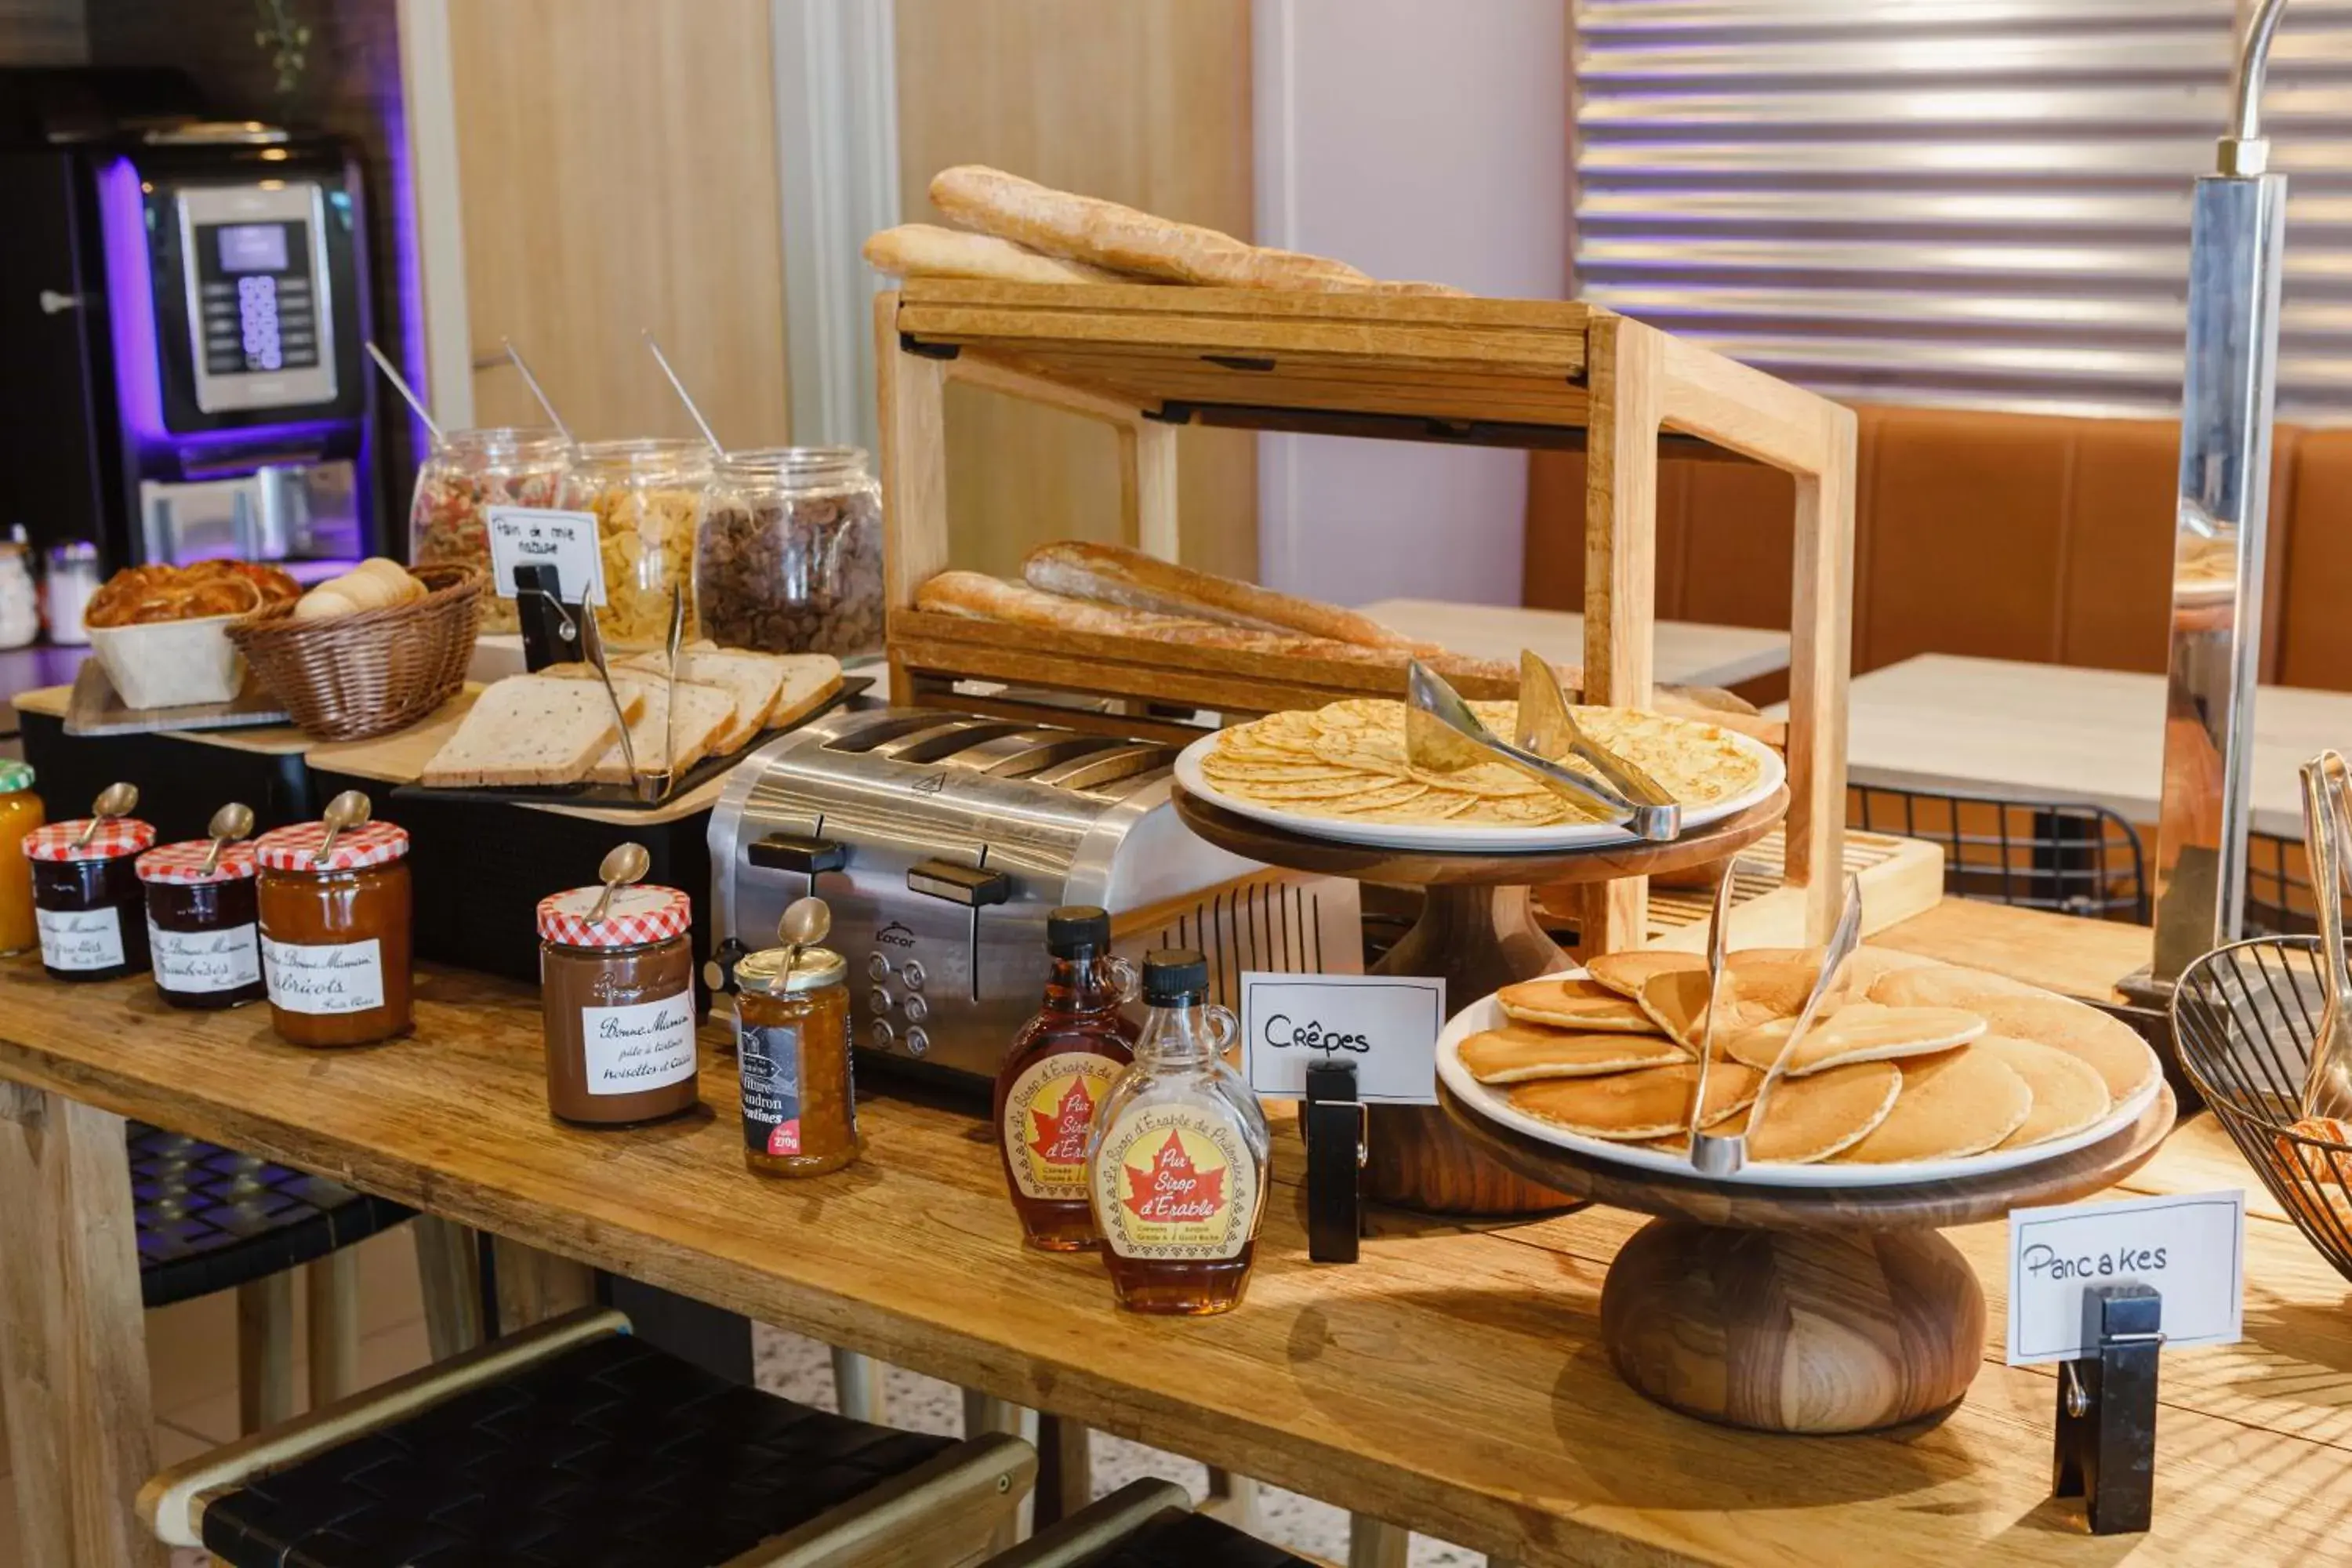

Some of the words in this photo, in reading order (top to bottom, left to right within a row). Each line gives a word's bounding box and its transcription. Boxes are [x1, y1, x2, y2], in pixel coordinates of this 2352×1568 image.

[529, 523, 541, 538] de
[551, 527, 575, 542] mie
[599, 1017, 644, 1040] Bonne
[1265, 1014, 1370, 1058] Crêpes
[1065, 1094, 1091, 1112] Pur
[774, 1137, 797, 1149] 270g
[1161, 1149, 1189, 1167] Pur
[1154, 1171, 1197, 1196] Sirop
[2024, 1243, 2167, 1279] Pancakes
